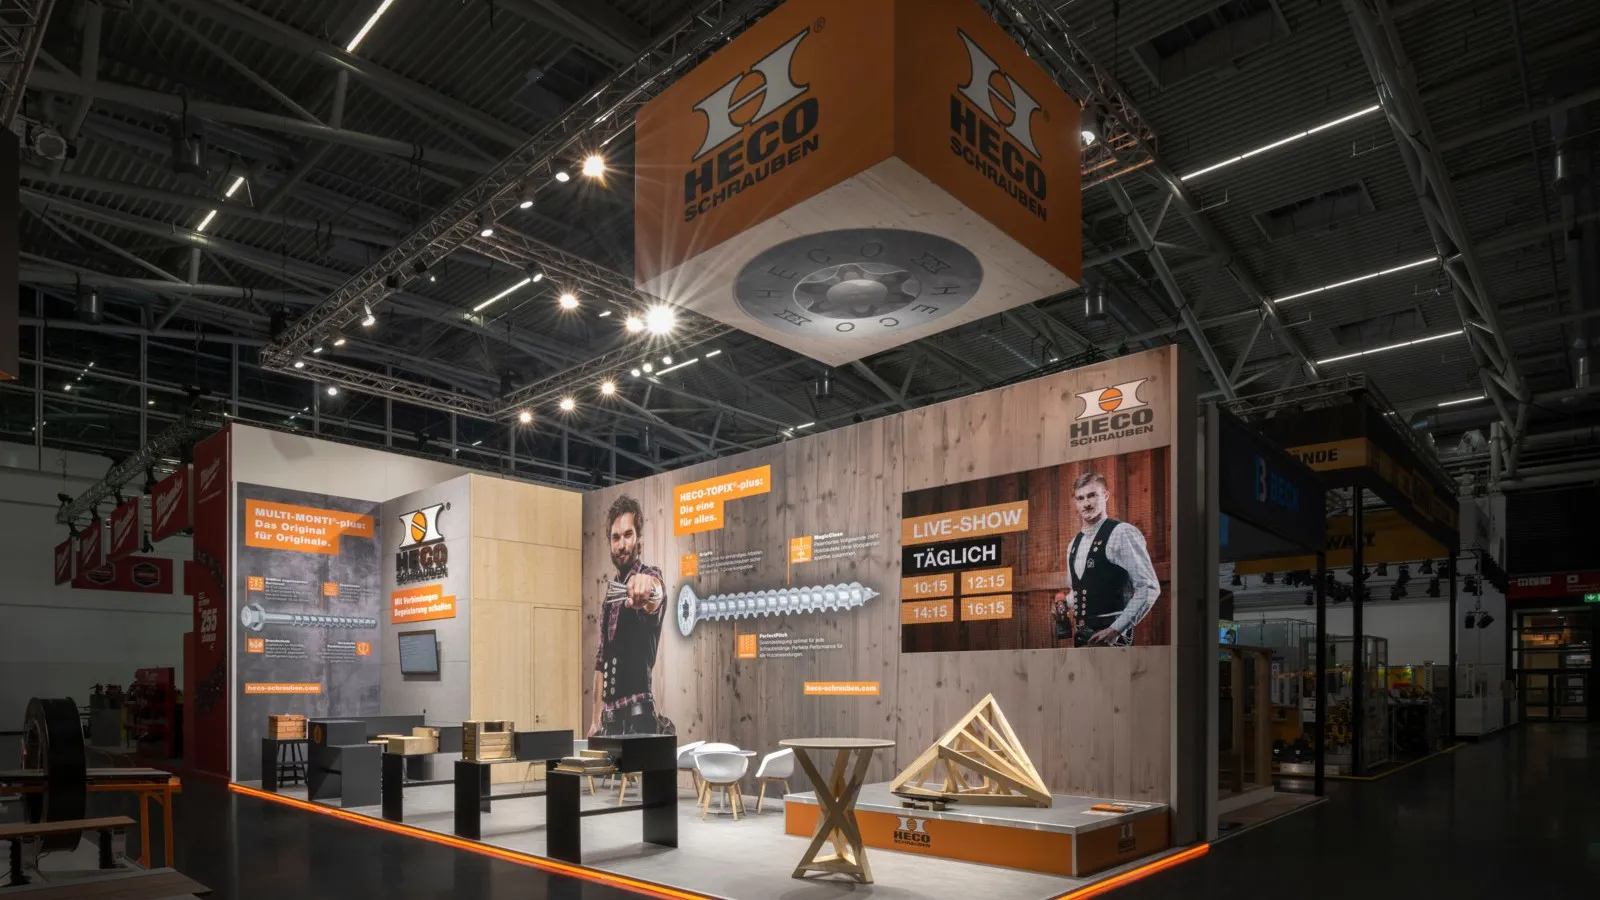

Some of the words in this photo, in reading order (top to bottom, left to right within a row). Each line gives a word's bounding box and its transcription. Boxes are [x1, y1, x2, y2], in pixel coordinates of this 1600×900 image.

[684, 97, 819, 204] HECO
[950, 93, 1047, 201] HECO
[684, 134, 819, 222] SCHRAUBEN
[950, 136, 1047, 222] SCHRAUBEN
[1070, 408, 1153, 439] HECO
[1070, 424, 1154, 447] SCHRAUBEN
[680, 505, 693, 515] Die
[696, 501, 715, 512] eine
[254, 519, 277, 530] Das
[281, 522, 326, 536] Original
[680, 517, 692, 528] für
[694, 514, 717, 525] alles.
[913, 508, 1023, 538] LIVE-SHOW
[254, 531, 272, 540] für
[276, 533, 332, 547] Originale.
[396, 543, 448, 572] HECO
[913, 544, 996, 569] TÄGLICH
[913, 580, 947, 593] 10:15
[968, 574, 1005, 589] 12:15
[913, 606, 947, 619] 14:15
[968, 601, 1005, 616] 16:15
[893, 831, 930, 843] HECO
